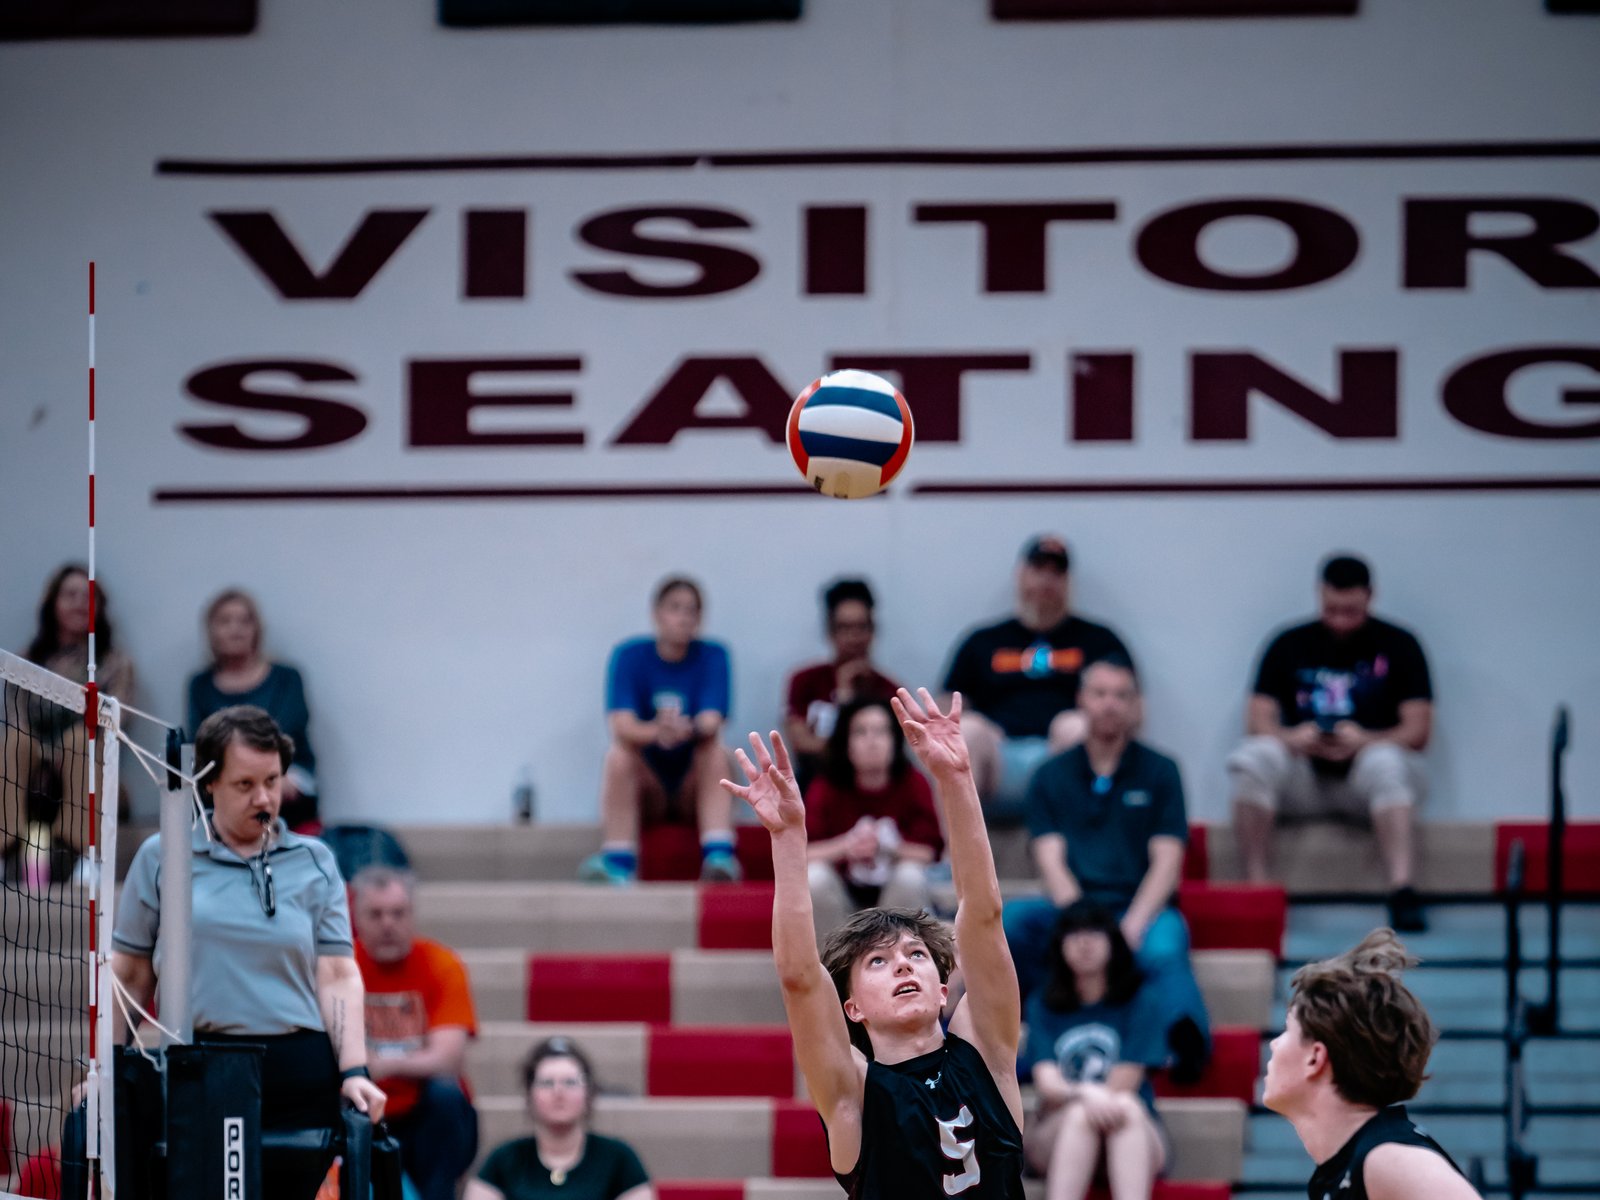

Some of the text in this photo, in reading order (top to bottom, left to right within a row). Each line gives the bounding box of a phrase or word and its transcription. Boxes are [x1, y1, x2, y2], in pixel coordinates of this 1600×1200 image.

[207, 197, 1600, 301] VISITOR
[178, 346, 1600, 452] SEATING
[935, 1104, 981, 1196] 5
